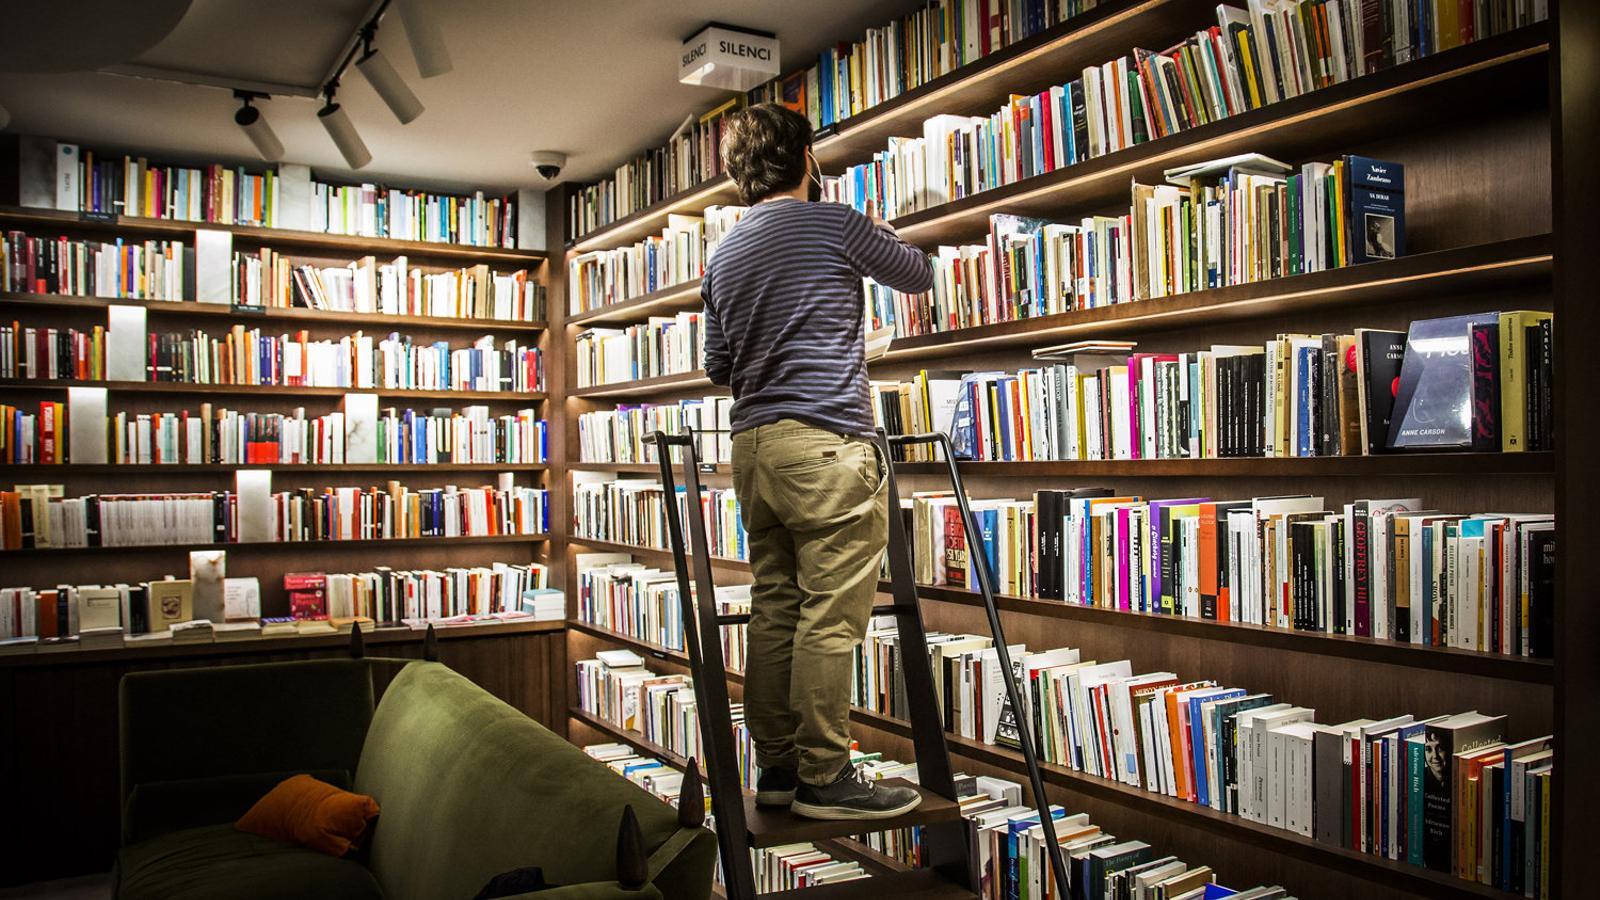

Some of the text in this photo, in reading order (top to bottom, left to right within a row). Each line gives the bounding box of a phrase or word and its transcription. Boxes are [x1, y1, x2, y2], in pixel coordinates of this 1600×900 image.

[682, 43, 707, 67] SILENCI
[719, 41, 771, 61] SILENCI
[1401, 428, 1446, 436] ANNE CARSON
[1355, 521, 1367, 580] GEOFFREY
[1355, 583, 1367, 604] HILL
[1461, 734, 1502, 752] Collected
